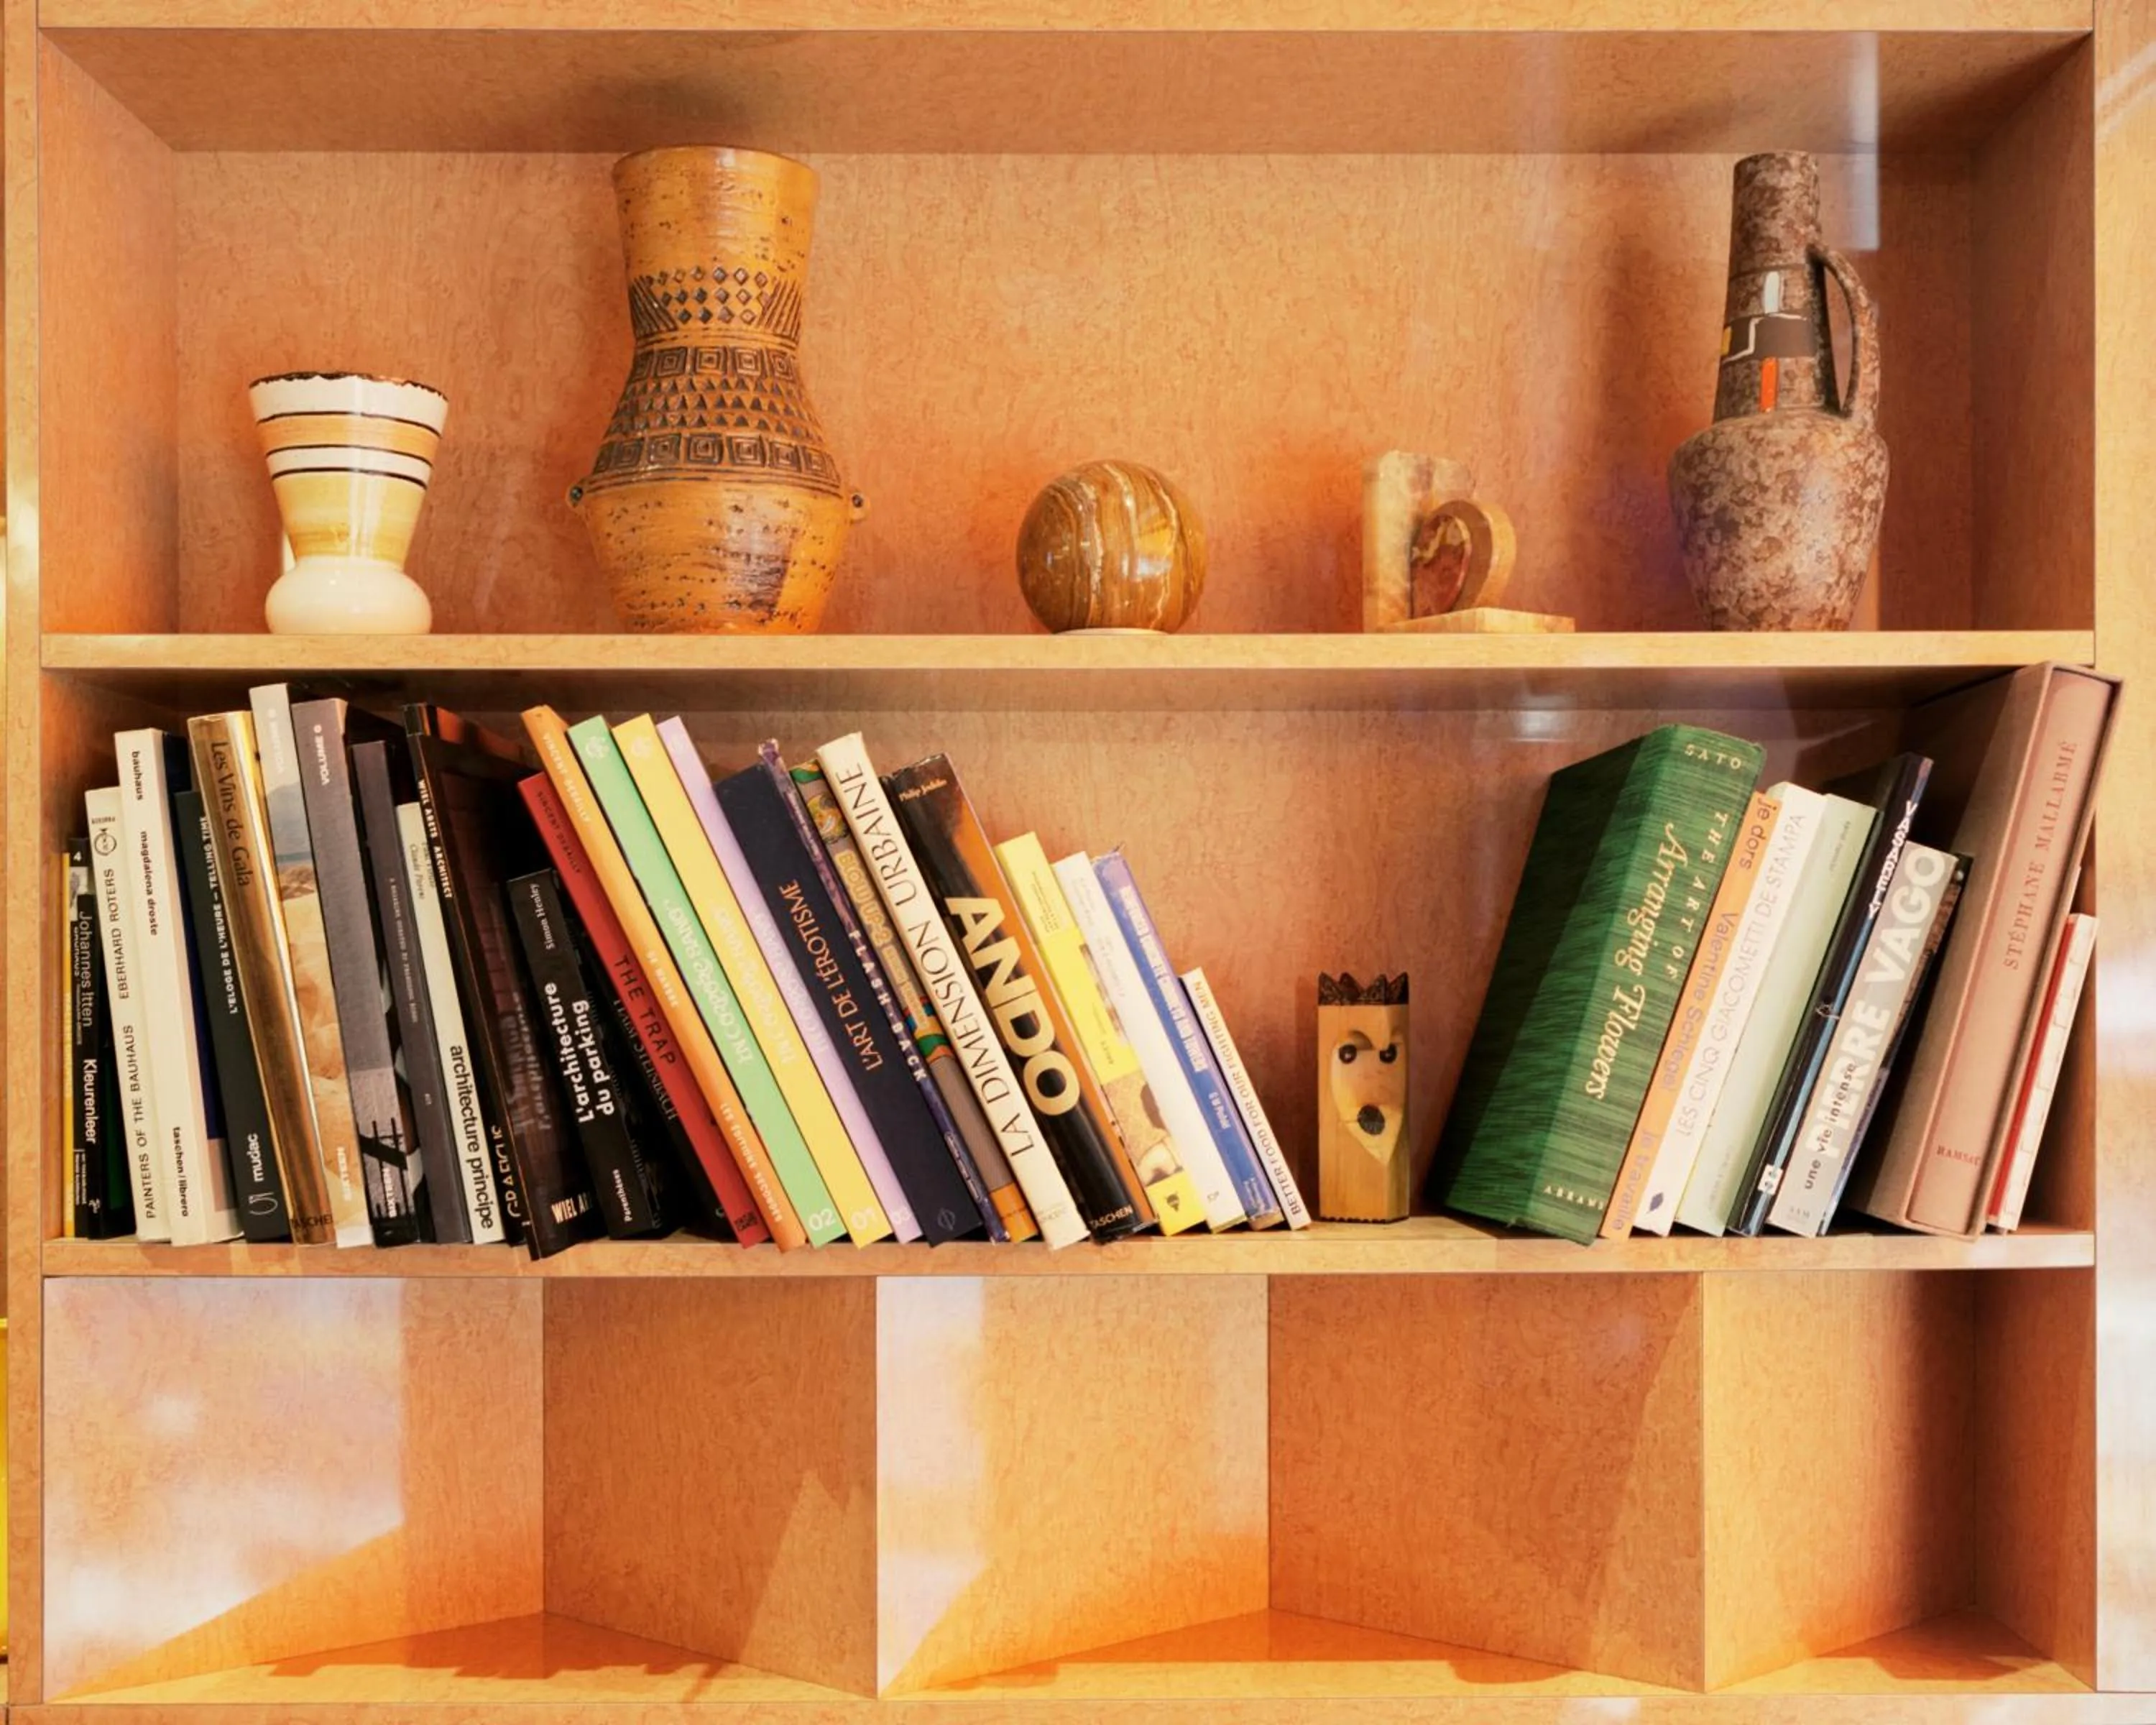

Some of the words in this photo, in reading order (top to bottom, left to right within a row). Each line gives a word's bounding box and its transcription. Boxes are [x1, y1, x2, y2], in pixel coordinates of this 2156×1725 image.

[130, 750, 146, 801] bauhaus
[209, 739, 234, 772] Les
[313, 735, 331, 786] VOLUME
[1684, 743, 1743, 770] SATO
[216, 772, 241, 813] Vins
[1752, 798, 1778, 822] je
[224, 816, 246, 841] de
[837, 762, 918, 906] URBAINE
[1701, 810, 1728, 863] THE
[1737, 822, 1769, 872] dors
[1764, 811, 1806, 889] STAMPA
[2005, 861, 2045, 970] STÉPHANE
[2033, 740, 2077, 851] MALLARMÉ
[137, 830, 155, 896] magdalena
[202, 842, 219, 888] TELLING
[229, 844, 255, 887] Gala
[433, 845, 453, 898] ARCHITECT
[1868, 799, 1918, 919] VASARELY
[101, 868, 121, 922] ROTERS
[145, 898, 159, 936] droste
[1614, 822, 1689, 976] Arranging
[1680, 875, 1706, 933] ART
[1753, 889, 1778, 919] DE
[1865, 845, 1946, 988] VAGO
[76, 911, 96, 988] Johannes
[219, 950, 231, 966] DE
[535, 917, 556, 951] Simon
[775, 878, 846, 991] L'ÉROTISME
[1690, 908, 1739, 1002] Valentine
[108, 926, 131, 1000] EBERHARD
[1667, 944, 1685, 980] OF
[1708, 919, 1766, 1043] GIACOMETTI
[80, 991, 96, 1027] Itten
[609, 953, 646, 1001] THE
[636, 1005, 680, 1068] TRAP
[830, 988, 859, 1018] DE
[908, 919, 1010, 1104] DIMENSION
[944, 898, 1080, 1116] ANDO
[120, 1024, 142, 1092] BAUHAUS
[542, 980, 594, 1124] L'architecture
[572, 1000, 607, 1085] parking
[844, 1016, 885, 1072] L'ART
[1203, 1009, 1238, 1070] FIGHTING
[1586, 984, 1646, 1100] Flowers
[1657, 1003, 1705, 1092] Schlegel
[595, 1085, 614, 1116] du
[1230, 1069, 1252, 1100] OUR
[1684, 1044, 1723, 1104] CINQ
[1824, 1062, 1857, 1123] intense
[80, 1058, 101, 1144] Kleurenleer
[130, 1097, 144, 1123] THE
[1243, 1098, 1263, 1128] FOR
[1674, 1104, 1700, 1137] LES
[134, 1127, 147, 1148] OF
[244, 1132, 264, 1182] mudac
[450, 1044, 480, 1153] architecture
[466, 1157, 494, 1229] principe
[1001, 1113, 1034, 1156] LA
[1256, 1127, 1280, 1165] FOOD
[1817, 1127, 1833, 1152] vie
[137, 1152, 157, 1220] PAINTERS
[1272, 1164, 1302, 1216] BETTER
[1610, 1152, 1651, 1233] travaille
[1804, 1159, 1821, 1190] une
